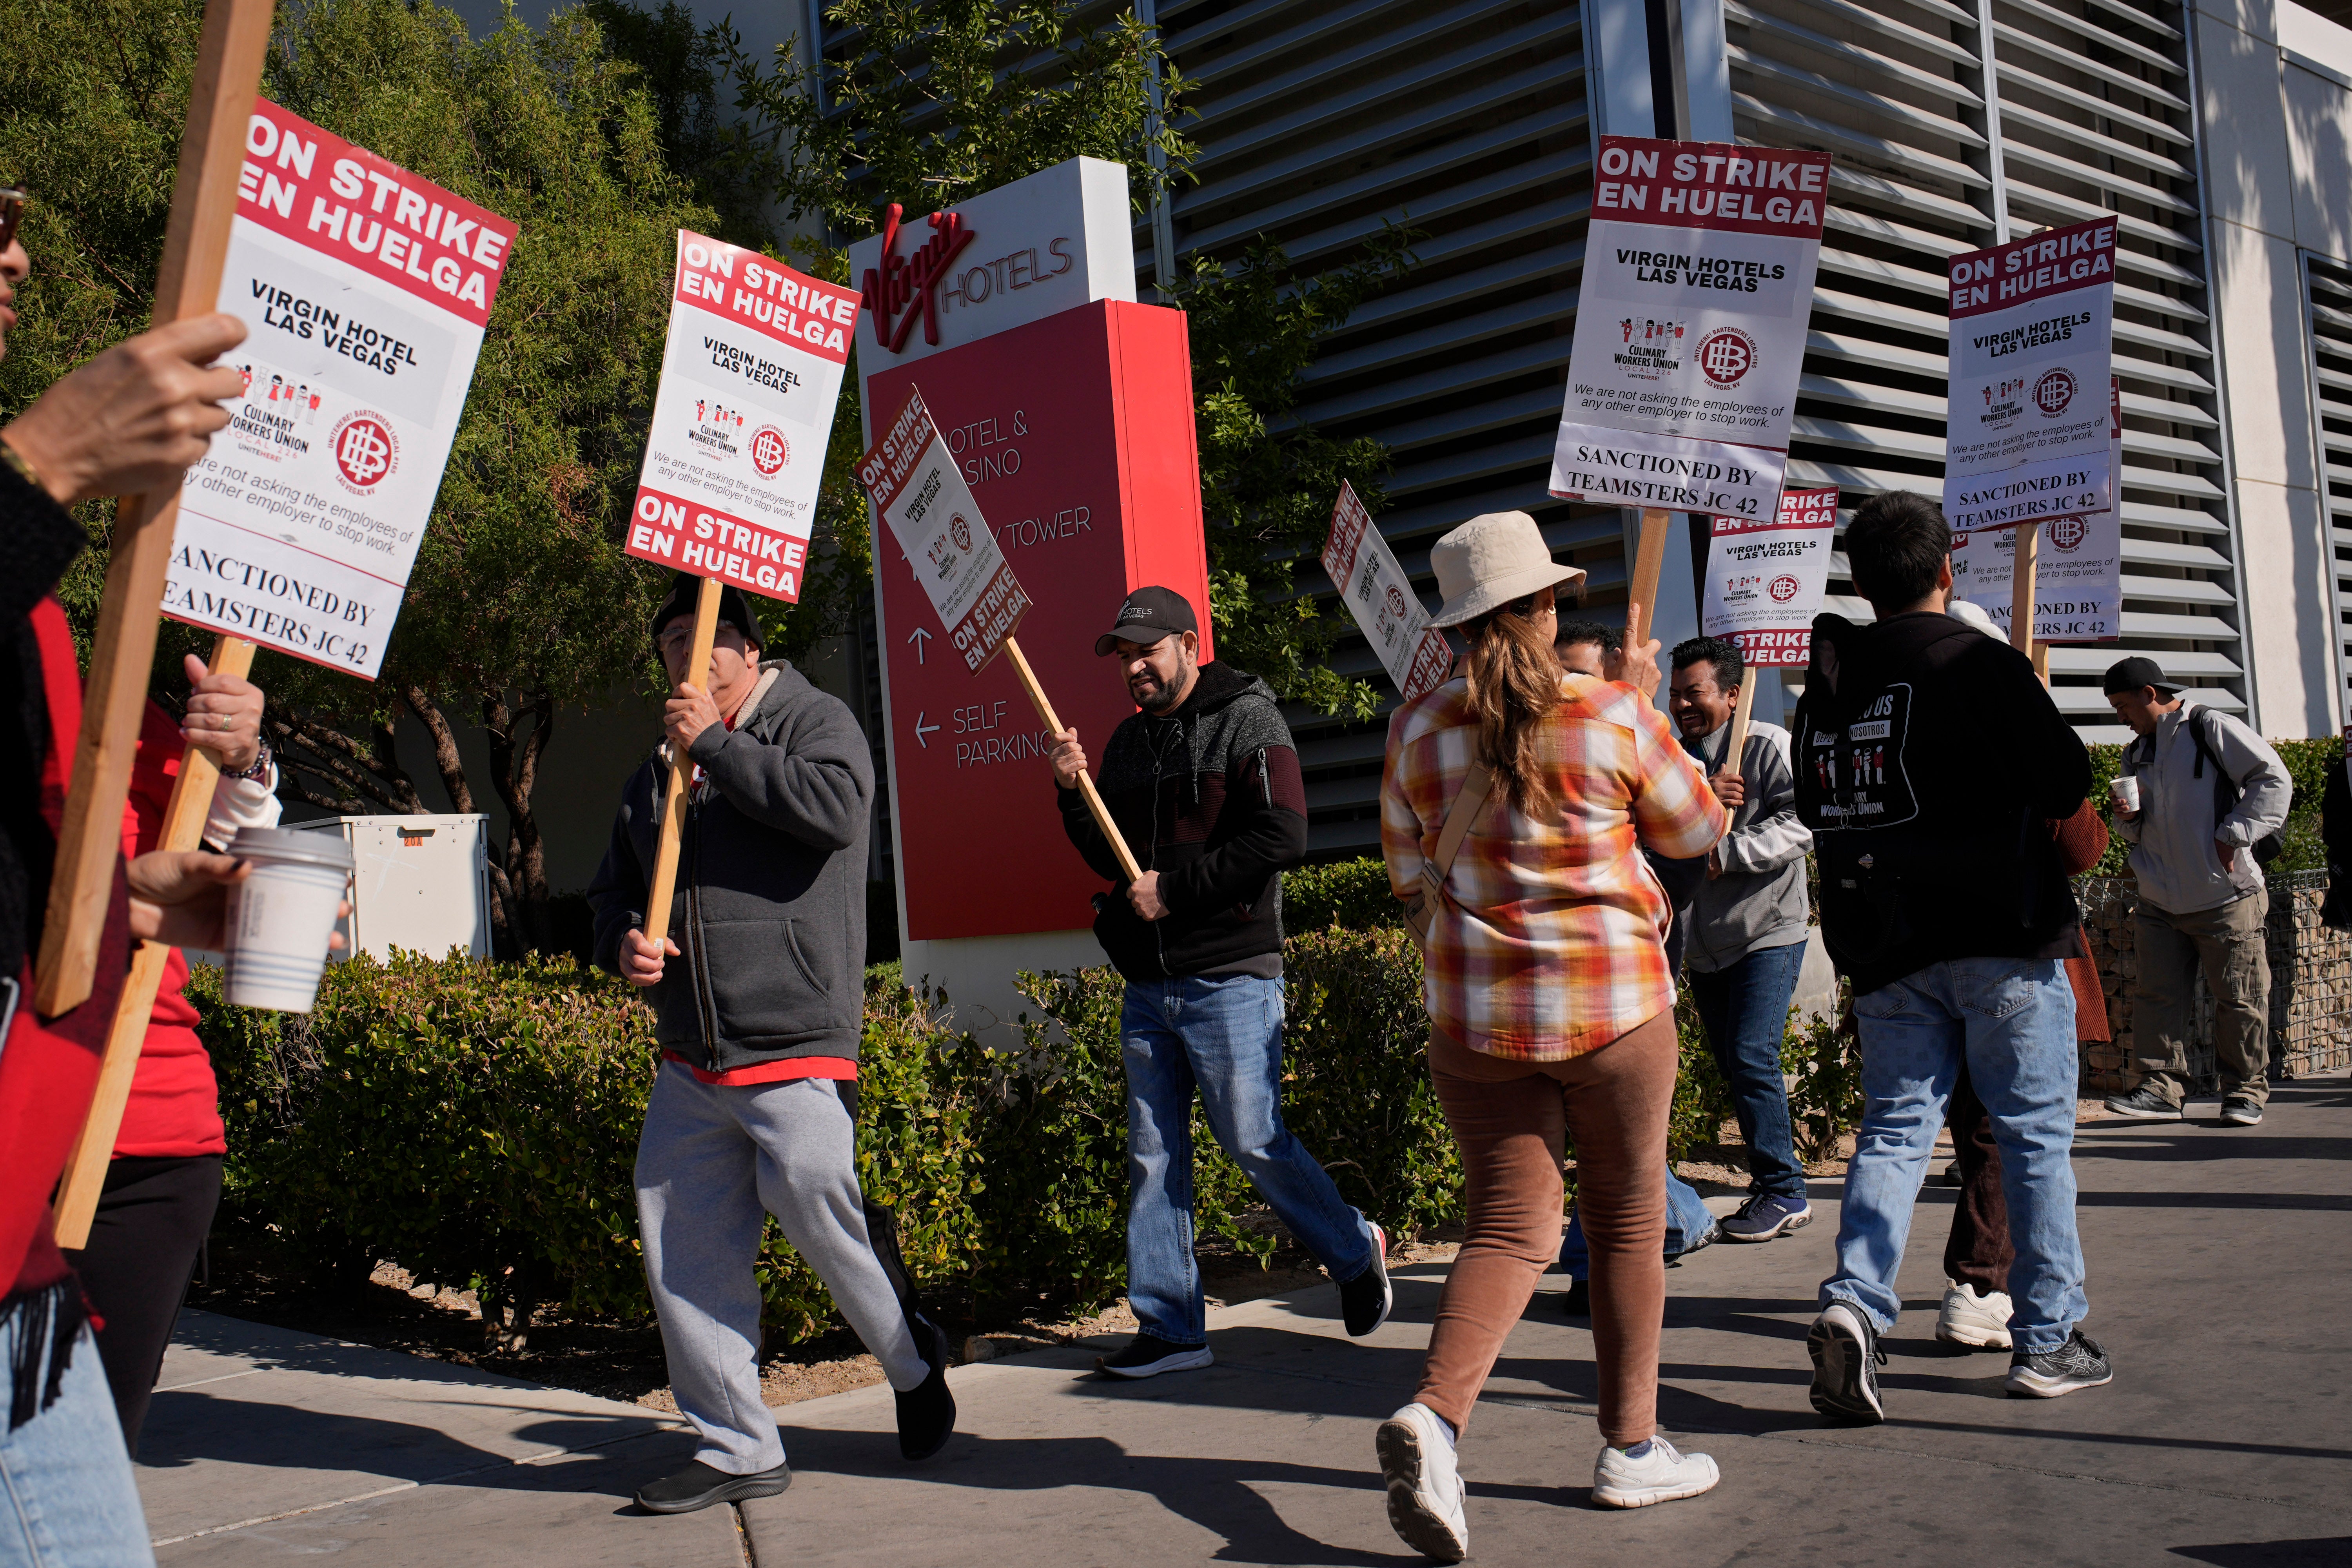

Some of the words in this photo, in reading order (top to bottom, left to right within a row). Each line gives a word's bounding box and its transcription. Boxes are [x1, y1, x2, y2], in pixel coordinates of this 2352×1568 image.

[1601, 148, 1659, 178] ON
[1673, 154, 1824, 192] STRIKE
[246, 115, 317, 180] ON
[330, 159, 507, 270] STRIKE
[1597, 182, 1648, 210] EN
[1660, 187, 1817, 225] HUELGA
[238, 161, 297, 219] EN
[307, 196, 485, 310] HUELGA
[1617, 249, 1691, 270] VIRGIN
[1698, 258, 1785, 279] HOTELS
[1952, 257, 1994, 284] ON
[2005, 225, 2113, 273] STRIKE
[684, 243, 733, 279] ON
[744, 263, 856, 326] STRIKE
[860, 203, 974, 354] Virgin
[941, 237, 1072, 313] HOTELS
[1637, 267, 1677, 284] LAS
[1685, 272, 1758, 292] VEGAS
[1953, 284, 1989, 310] EN
[2000, 254, 2110, 300] HUELGA
[252, 278, 339, 330] VIRGIN
[347, 320, 417, 366] HOTEL
[682, 270, 724, 304] EN
[733, 288, 844, 353] HUELGA
[264, 307, 314, 339] LAS
[324, 329, 397, 375] VEGAS
[1694, 332, 1712, 362] UNITEHERE!
[1713, 327, 1748, 338] BARTENDERS
[1746, 337, 1758, 353] LOCAL
[1973, 327, 2024, 348] VIRGIN
[2029, 312, 2091, 336] HOTELS
[1991, 342, 2017, 358] LAS
[2021, 328, 2072, 349] VEGAS
[704, 336, 754, 366] VIRGIN
[758, 359, 800, 386] HOTEL
[1614, 353, 1650, 367] WORKERS
[1653, 358, 1679, 370] UNION
[1619, 365, 1650, 373] LOCAL
[1629, 345, 1666, 358] CULINARY
[712, 353, 740, 373] LAS
[745, 366, 788, 393] VEGAS
[1704, 378, 1713, 387] LAS
[243, 405, 294, 432] CULINARY
[1575, 384, 1593, 396] We
[1597, 387, 1614, 397] are
[1618, 389, 1637, 400] not
[1640, 392, 1678, 407] asking
[1681, 396, 1700, 408] the
[1704, 399, 1768, 416] employees
[1771, 406, 1784, 417] of
[1581, 399, 1601, 411] any
[1605, 400, 1635, 413] other
[1638, 406, 1693, 421] employer
[1695, 410, 1707, 421] to
[1710, 414, 1735, 426] stop
[1739, 417, 1770, 428] work.
[1980, 411, 2007, 423] WORKERS
[2008, 406, 2023, 417] UNION
[1991, 401, 2015, 413] CULINARY
[275, 431, 309, 453] UNION
[689, 430, 716, 447] WORKERS
[718, 442, 737, 455] UNION
[692, 441, 715, 453] LOCAL
[701, 425, 729, 442] CULINARY
[862, 453, 886, 486] ON
[883, 393, 923, 460] STRIKE
[944, 417, 1008, 454] OTEL
[1014, 410, 1028, 436] &
[699, 450, 722, 462] UNITEHERE!
[873, 475, 894, 505] EN
[891, 416, 932, 482] HUELGA
[1577, 446, 1720, 480] SANCTIONED
[1726, 467, 1757, 486] BY
[654, 451, 670, 464] We
[673, 457, 687, 470] are
[690, 461, 704, 475] not
[706, 469, 735, 488] asking
[736, 479, 748, 491] the
[750, 486, 795, 508] employees
[797, 502, 808, 511] of
[658, 466, 675, 481] any
[678, 471, 702, 486] other
[704, 479, 747, 501] employer
[745, 495, 752, 504] to
[754, 499, 772, 512] stop
[773, 506, 796, 519] work.
[905, 490, 925, 520] VIRGIN
[922, 467, 940, 494] HOTEL
[1568, 472, 1699, 505] TEAMSTERS
[1704, 492, 1731, 509] JC
[1736, 499, 1757, 514] 42
[1960, 476, 2061, 506] SANCTIONED
[2067, 471, 2091, 486] BY
[913, 505, 926, 523] LAS
[924, 480, 941, 507] VEGAS
[1954, 499, 2047, 528] TEAMSTERS
[2052, 496, 2073, 511] JC
[2078, 493, 2095, 507] 42
[638, 495, 686, 531] ON
[694, 513, 804, 568] STRIKE
[1005, 506, 1091, 549] TOWER
[1325, 545, 1338, 574] ON
[1334, 486, 1355, 549] STRIKE
[1715, 518, 1741, 531] EN
[632, 524, 675, 557] EN
[682, 539, 795, 596] HUELGA
[1334, 564, 1346, 590] EN
[1341, 505, 1364, 568] HUELGA
[1726, 544, 1766, 555] VIRGIN
[1769, 541, 1817, 550] HOTELS
[1737, 552, 1759, 561] LAS
[1763, 549, 1802, 557] VEGAS
[172, 544, 339, 615] ANCTIONED
[343, 603, 375, 627] BY
[1357, 572, 1367, 600] VIRGIN
[1365, 550, 1378, 573] HOTEL
[1368, 561, 1379, 587] VEGAS
[162, 579, 310, 646] EAMSTERS
[314, 630, 344, 656] JC
[346, 642, 368, 665] 42
[955, 620, 977, 650] ON
[975, 566, 1015, 627] STRIKE
[2080, 602, 2102, 613] BY
[965, 641, 985, 670] EN
[982, 590, 1027, 649] HUELGA
[2065, 622, 2085, 634] JC
[2089, 622, 2105, 633] 42
[1741, 649, 1810, 662] UELGA
[953, 701, 1008, 734] SELF
[1874, 695, 1893, 716] US
[1850, 724, 1884, 737] NOSOTROS
[1858, 802, 1884, 814] UNION
[405, 837, 421, 846] 20A
